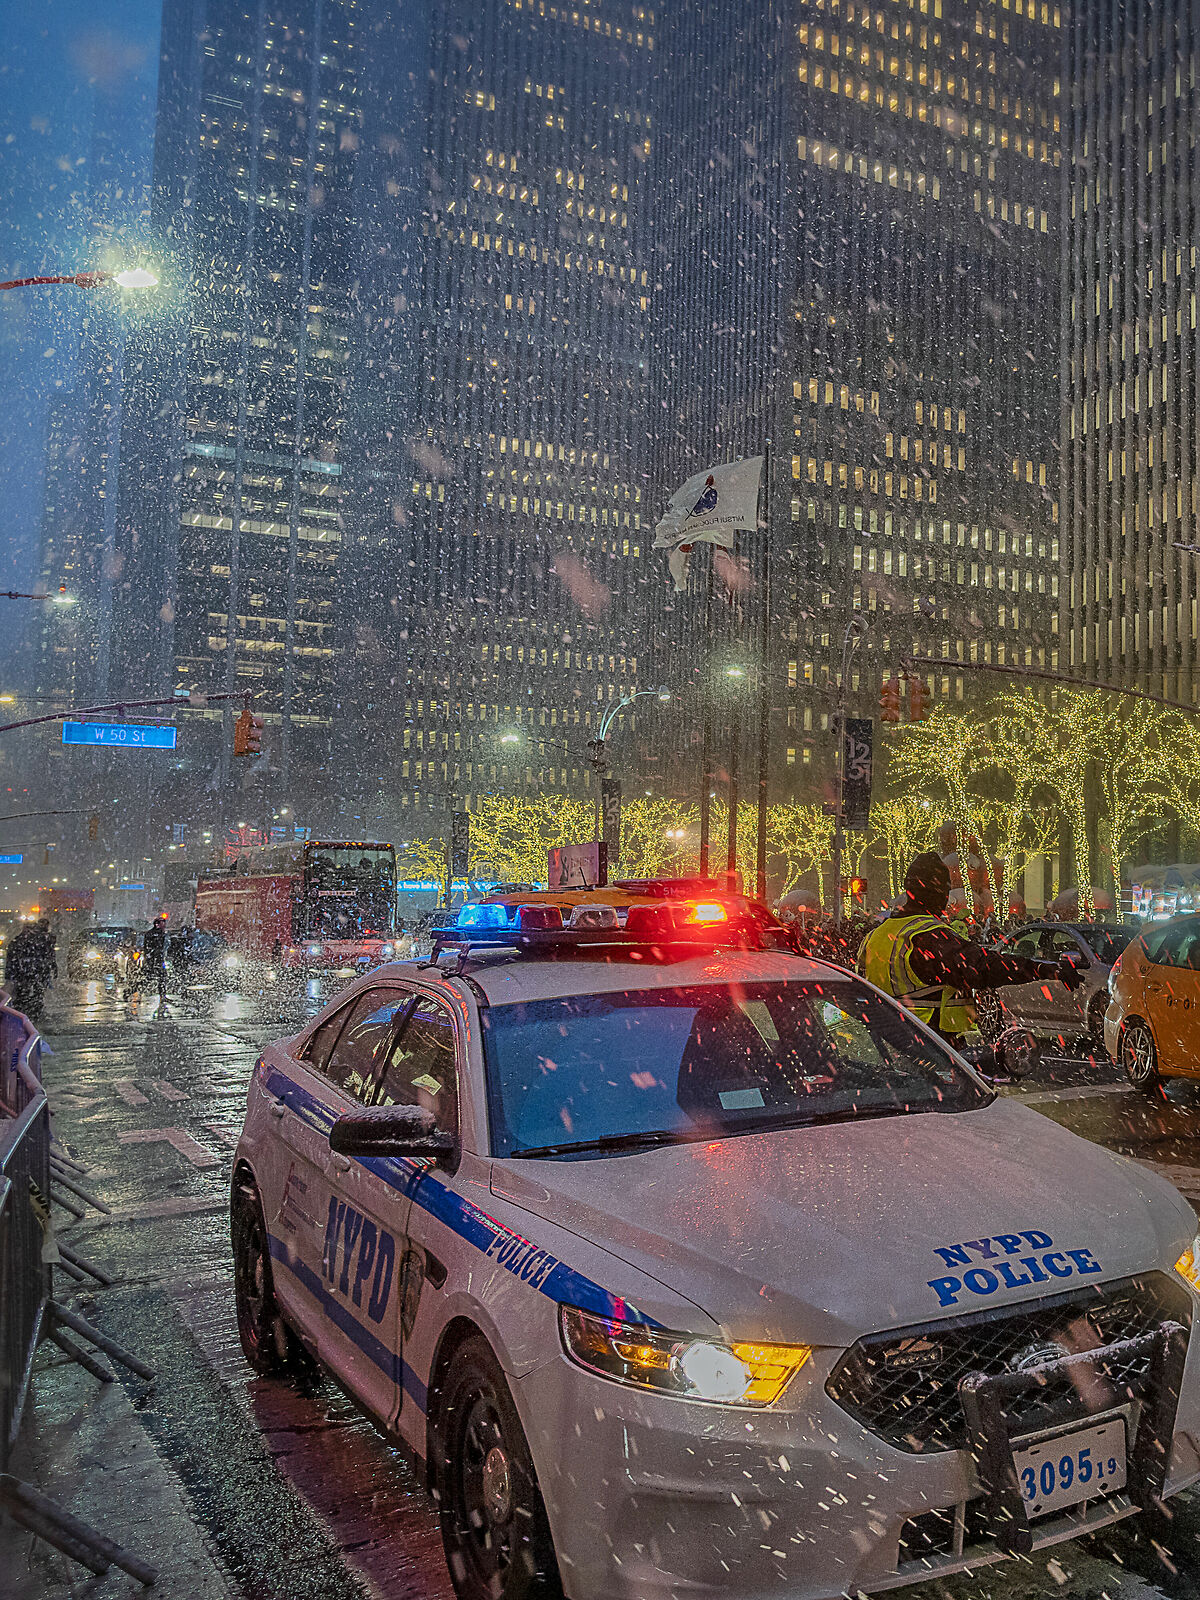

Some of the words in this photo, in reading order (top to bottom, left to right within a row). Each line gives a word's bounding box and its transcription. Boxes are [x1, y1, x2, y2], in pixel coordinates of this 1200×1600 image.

[94, 728, 105, 740] W
[110, 729, 127, 741] 50
[132, 730, 146, 742] St
[322, 1195, 396, 1325] NYPD
[485, 1232, 560, 1289] POLICE
[933, 1230, 1053, 1269] NYPD
[927, 1249, 1103, 1308] POLICE
[1021, 1448, 1093, 1501] 3095
[1096, 1457, 1117, 1479] 19
